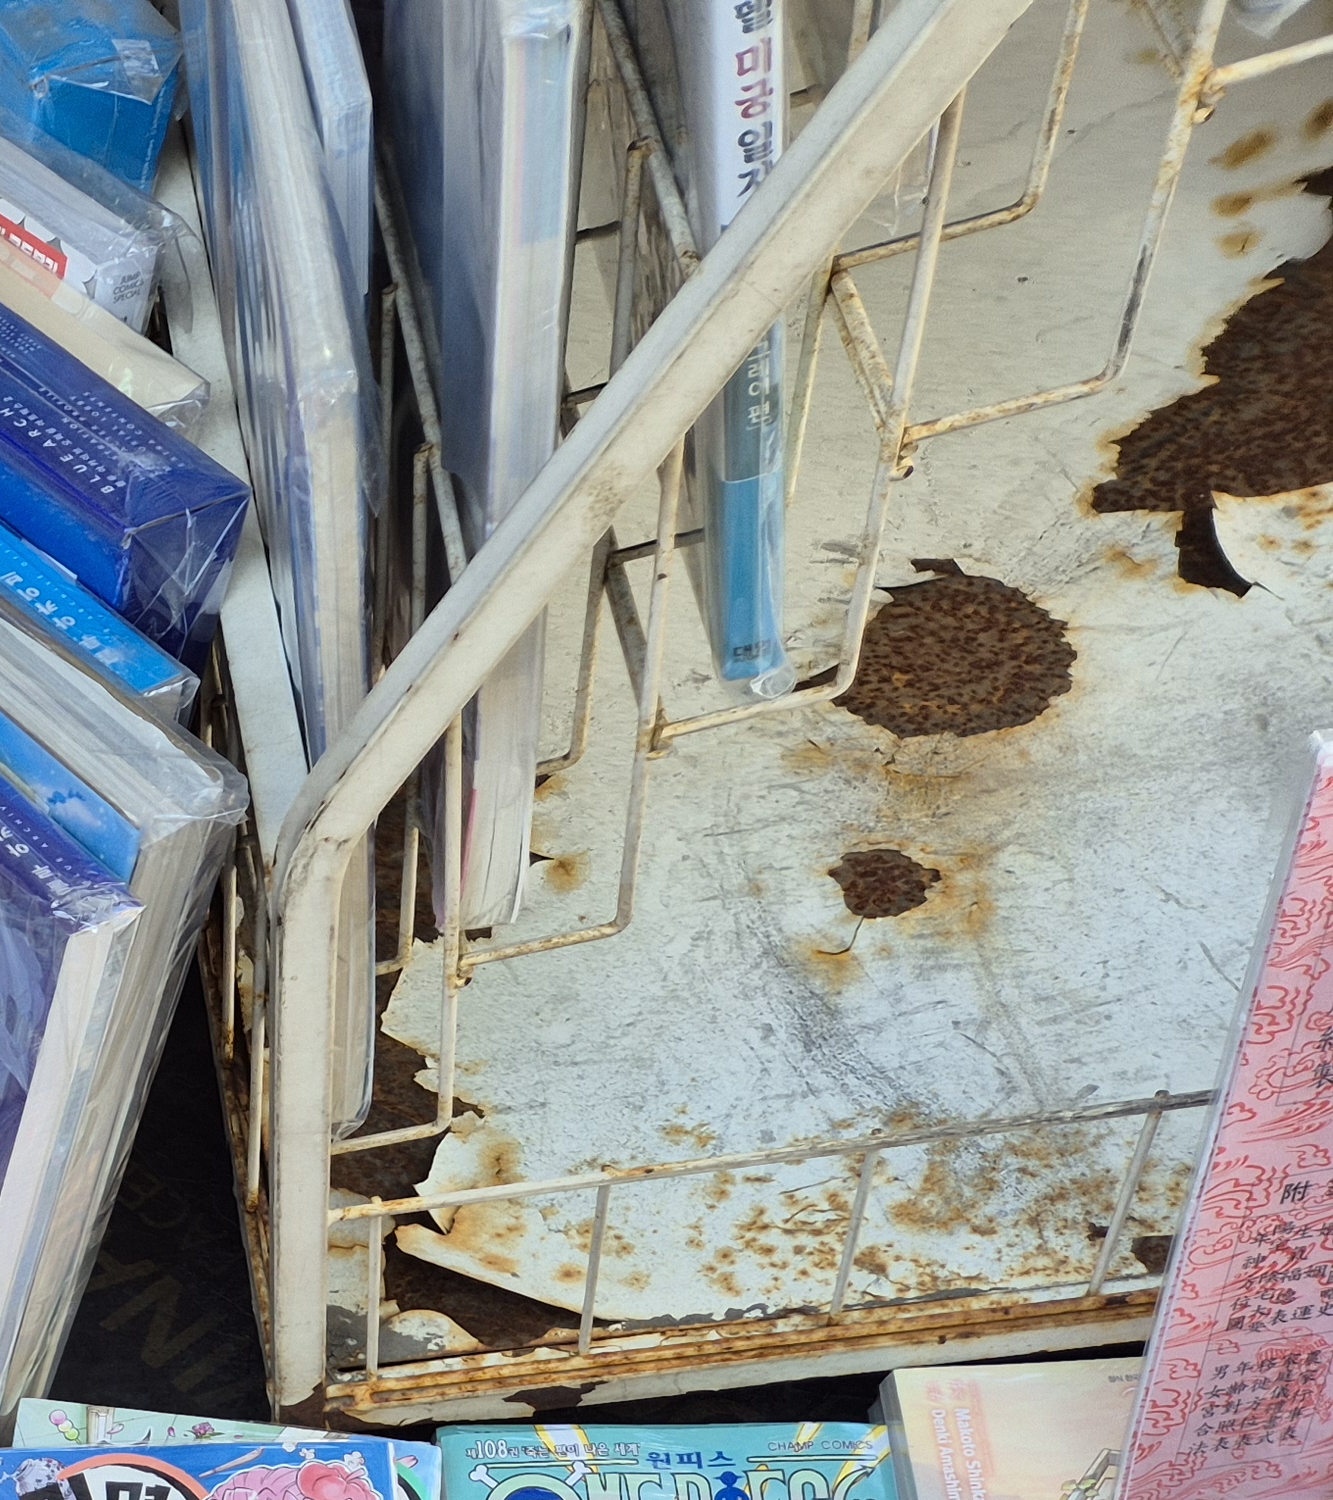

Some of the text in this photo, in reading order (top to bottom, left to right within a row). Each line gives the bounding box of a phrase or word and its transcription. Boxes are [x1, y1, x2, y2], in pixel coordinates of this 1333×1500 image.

[734, 46, 775, 118] 미궁
[114, 277, 145, 293] COMICS
[119, 270, 141, 285] JUMP
[113, 288, 142, 304] SPECIAL
[59, 453, 115, 495] BLUE
[931, 1408, 947, 1441] Denki
[955, 1407, 976, 1458] Makoto
[465, 1439, 519, 1460] 제108권
[767, 1439, 873, 1452] CHAMP COMICS
[647, 1451, 736, 1470] 원피스
